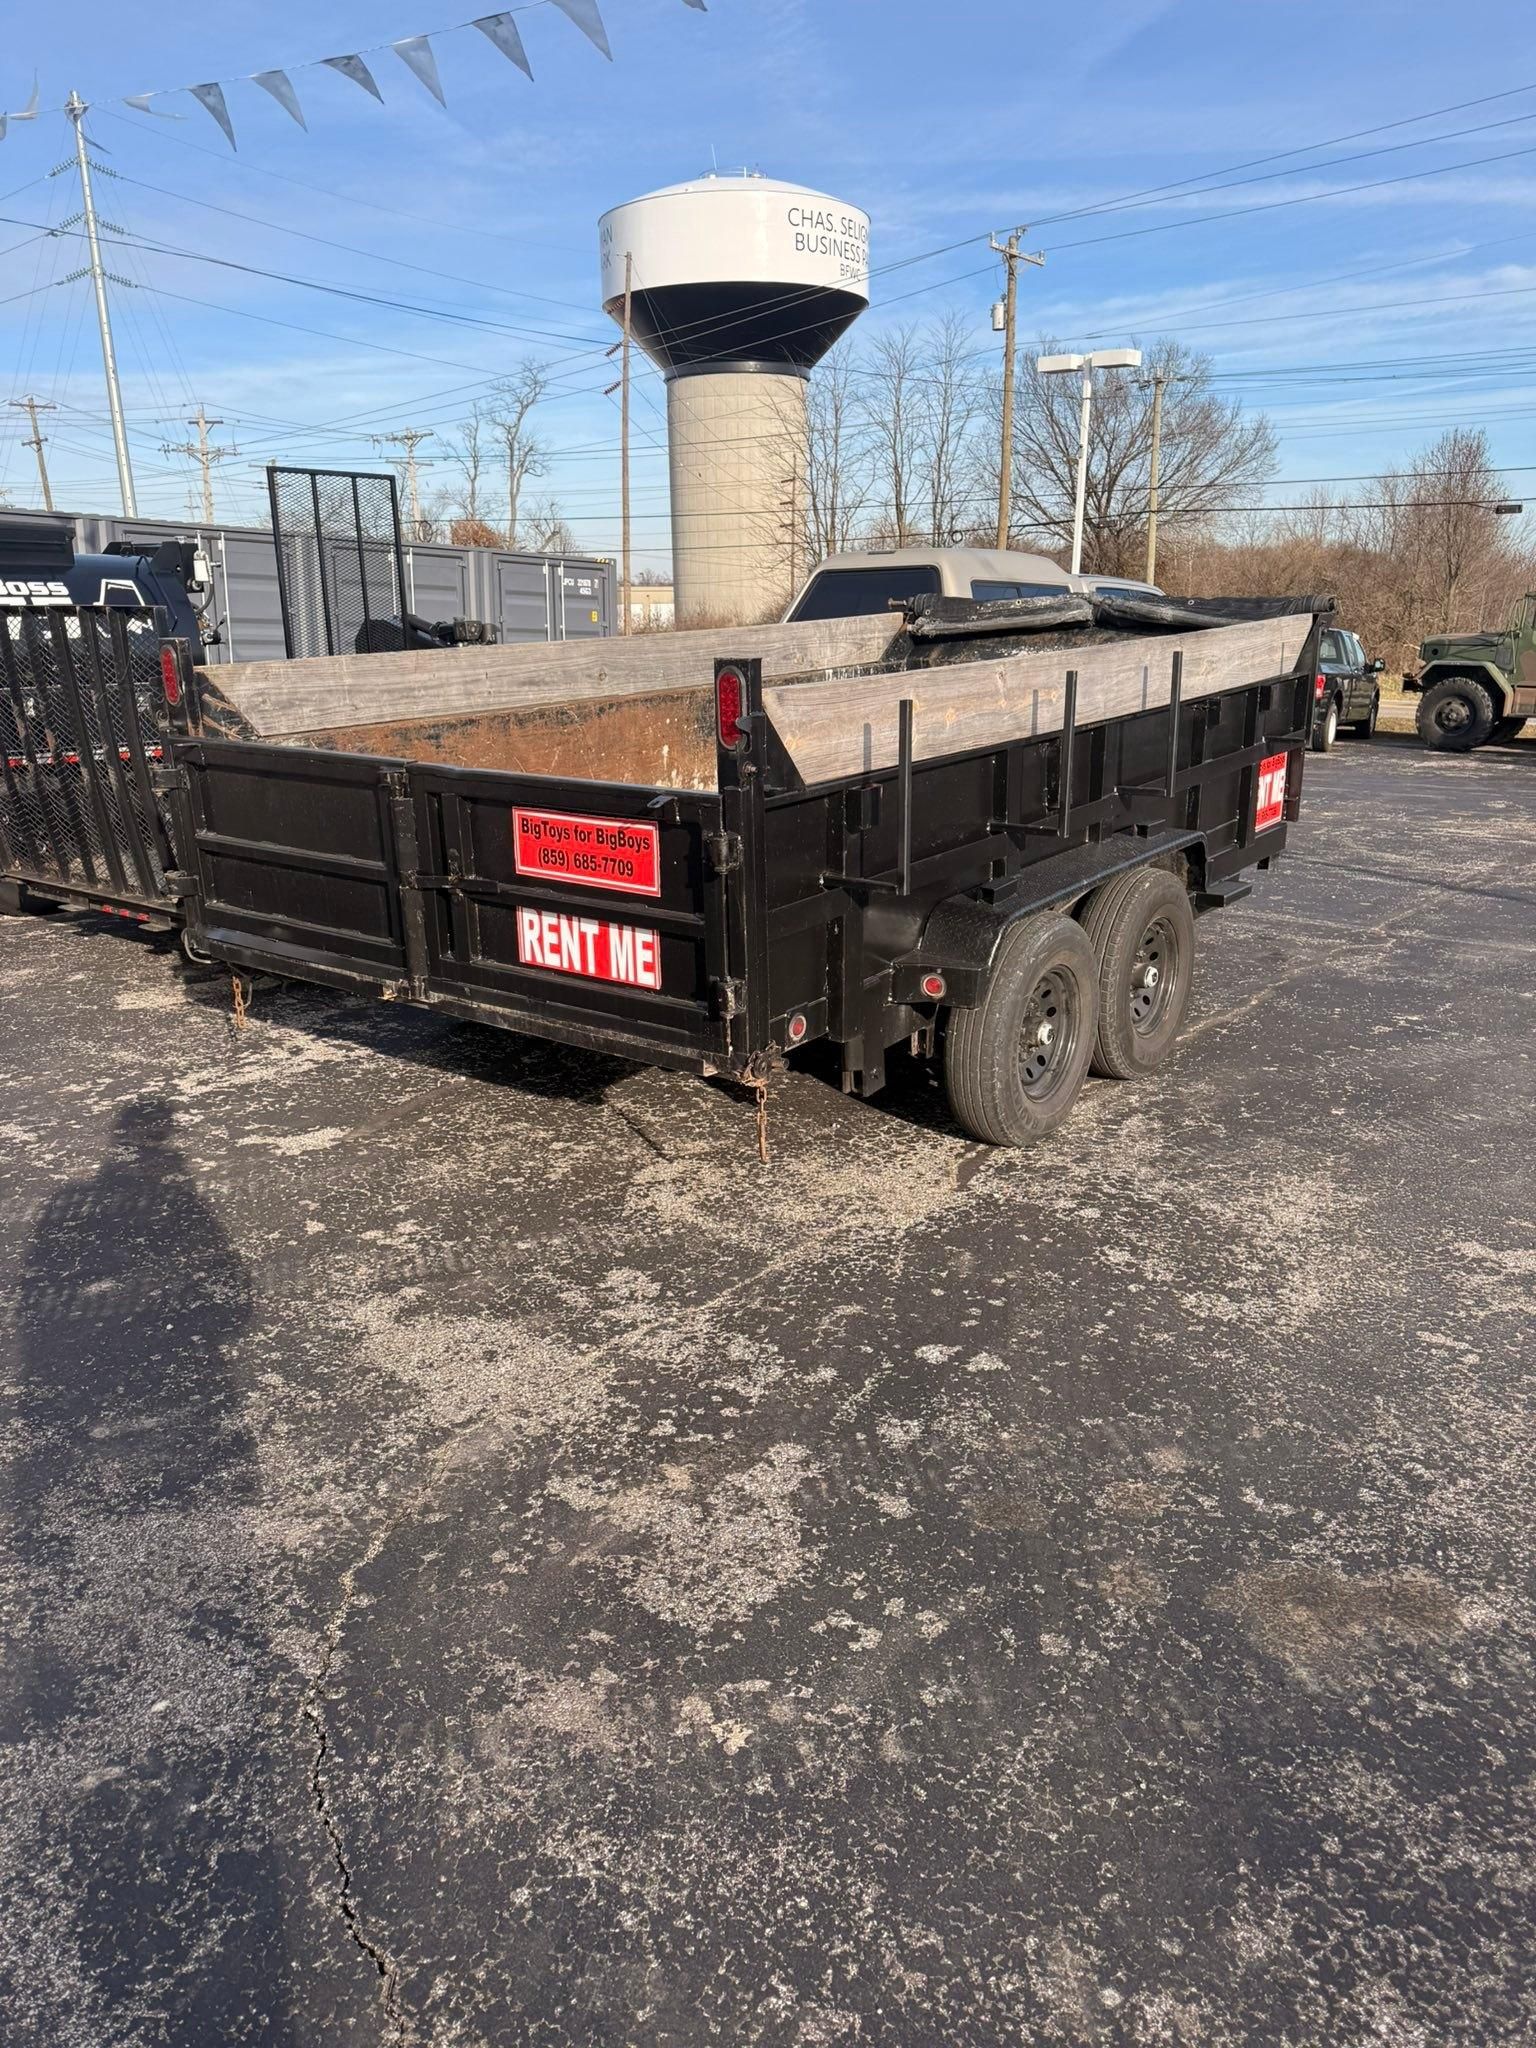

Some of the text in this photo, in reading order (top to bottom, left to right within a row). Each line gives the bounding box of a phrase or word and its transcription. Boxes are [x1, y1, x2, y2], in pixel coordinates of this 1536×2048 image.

[788, 207, 837, 232] CHAS.
[795, 232, 861, 264] BUSINESS
[521, 817, 650, 853] BigToys for BigBoys
[538, 848, 634, 877] (859) 685-7709
[522, 906, 656, 987] RENT ME
